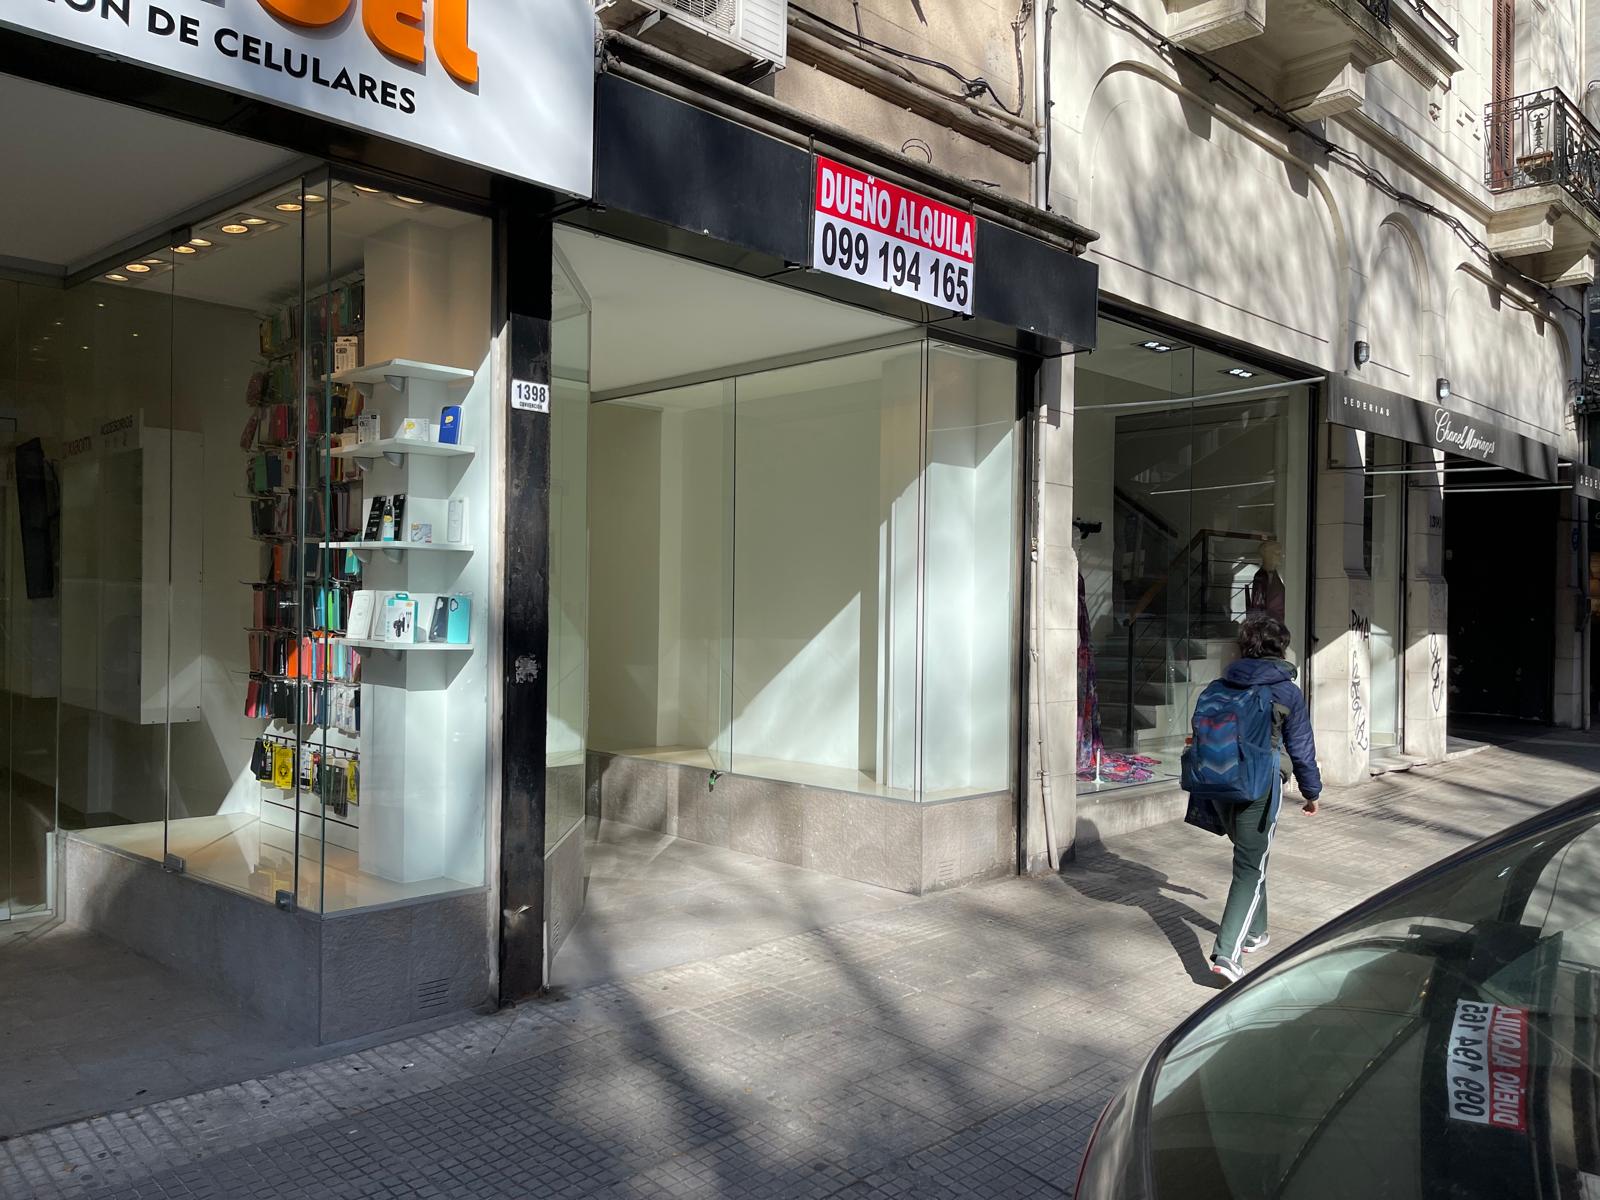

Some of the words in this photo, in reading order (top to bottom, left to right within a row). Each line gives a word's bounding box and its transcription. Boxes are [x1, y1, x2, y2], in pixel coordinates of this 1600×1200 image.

[148, 5, 200, 47] DE
[213, 28, 416, 114] CELULARES
[821, 167, 891, 229] DUEÑO
[896, 197, 973, 258] ALQUILA
[822, 222, 869, 275] 099
[879, 241, 921, 292] 194
[930, 258, 969, 306] 165
[517, 383, 546, 403] 1398
[1343, 396, 1390, 417] SEDERIAS
[1435, 408, 1468, 444] Chanel
